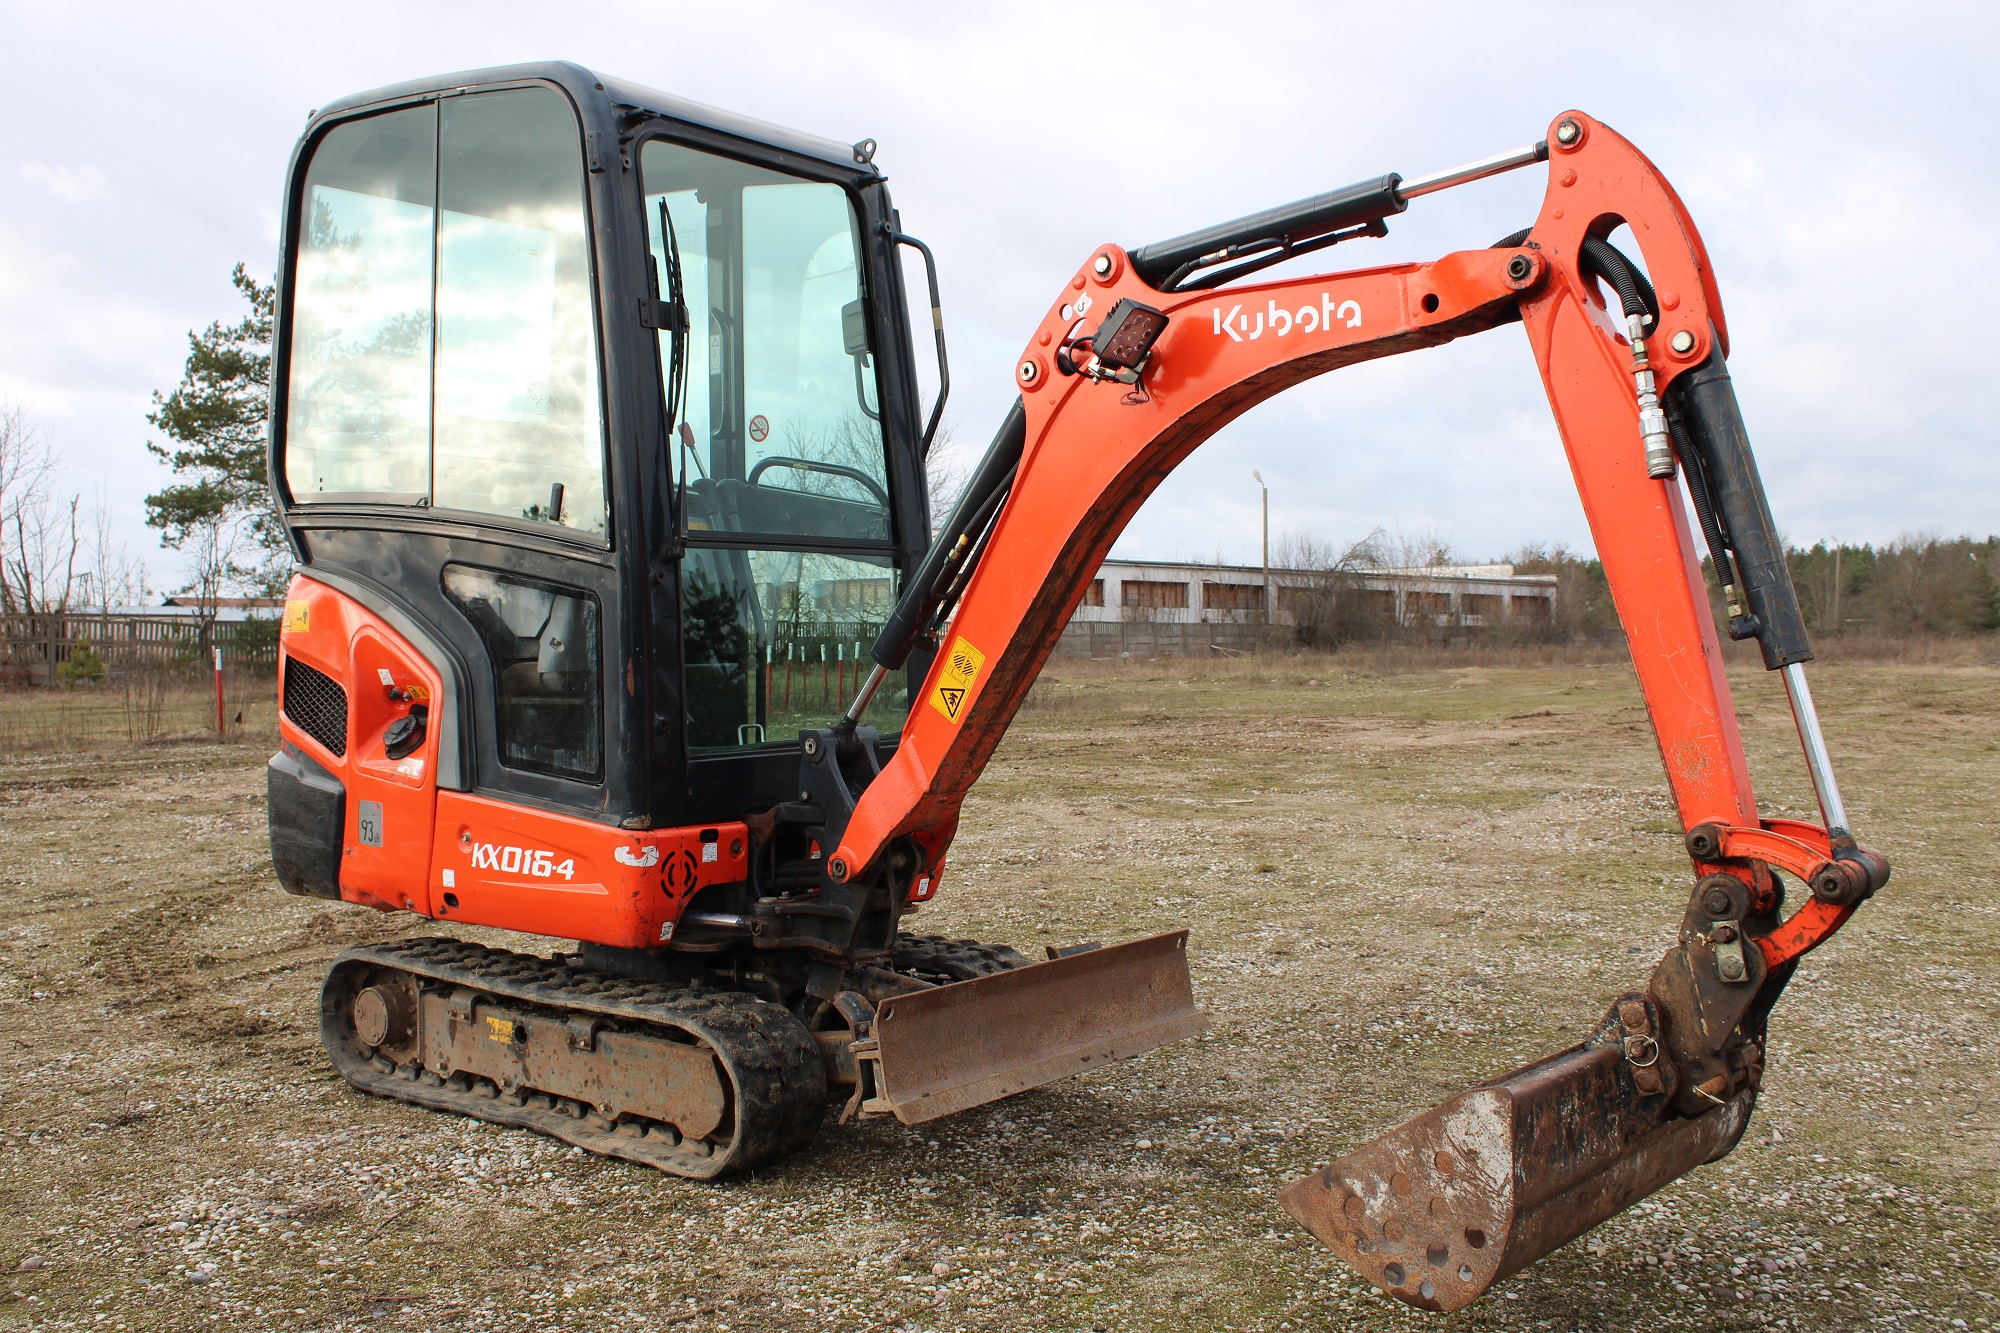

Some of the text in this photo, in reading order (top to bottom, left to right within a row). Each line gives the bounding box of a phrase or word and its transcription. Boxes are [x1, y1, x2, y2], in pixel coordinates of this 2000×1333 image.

[1213, 292, 1362, 342] Kubota
[361, 819, 373, 841] 93
[471, 842, 574, 880] KX016-4
